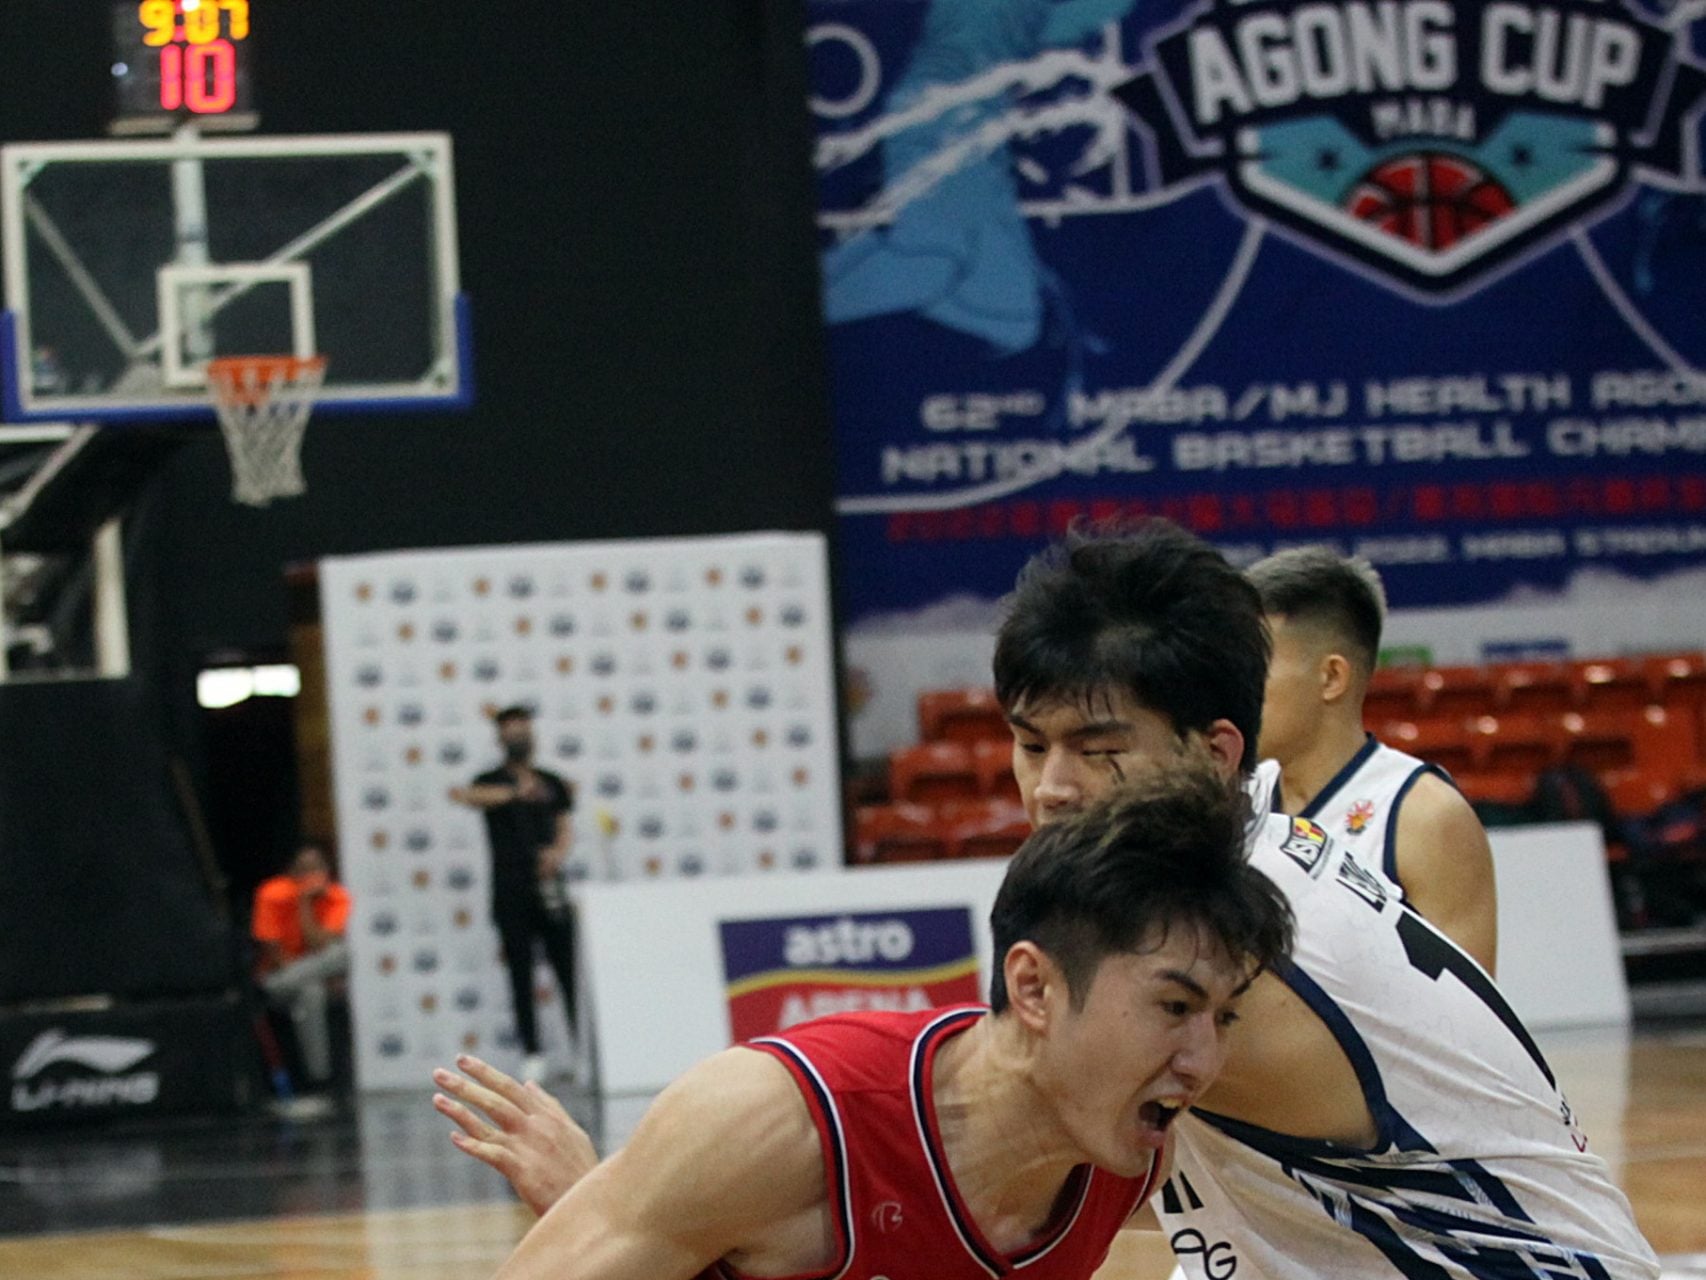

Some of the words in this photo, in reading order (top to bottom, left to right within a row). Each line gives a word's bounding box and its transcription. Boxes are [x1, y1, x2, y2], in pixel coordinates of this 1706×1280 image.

[160, 38, 236, 114] 10
[1187, 0, 1458, 124] AGONG
[1481, 1, 1643, 108] CUP
[1366, 373, 1572, 418] HEALTH
[1592, 369, 1706, 411] AGO
[881, 434, 1157, 483] NATIONAL
[1173, 419, 1531, 471] BASKETBALL
[1547, 414, 1706, 457] CHAM
[783, 917, 914, 965] astro
